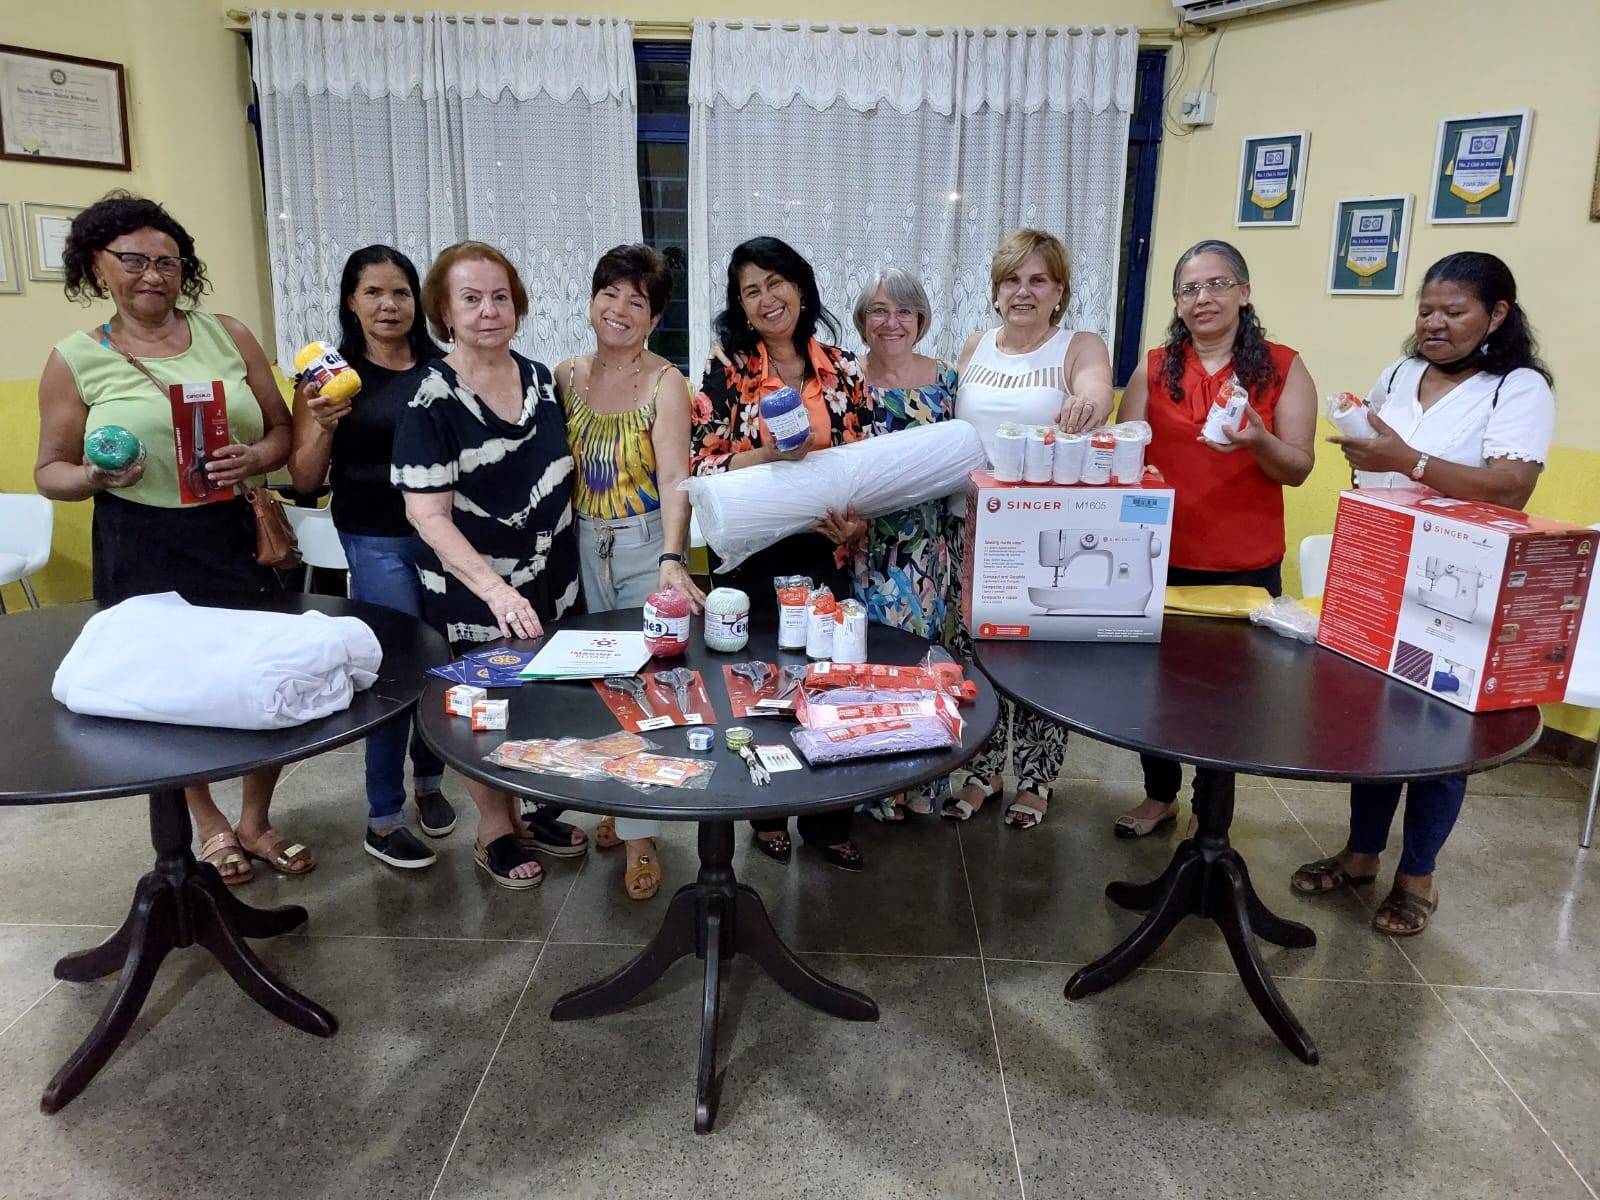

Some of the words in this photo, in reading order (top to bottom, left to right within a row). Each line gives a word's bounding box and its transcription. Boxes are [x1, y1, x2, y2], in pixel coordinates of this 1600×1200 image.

[1007, 501, 1062, 510] SINGER
[1075, 502, 1107, 510] M1605
[1434, 526, 1469, 540] SINGER
